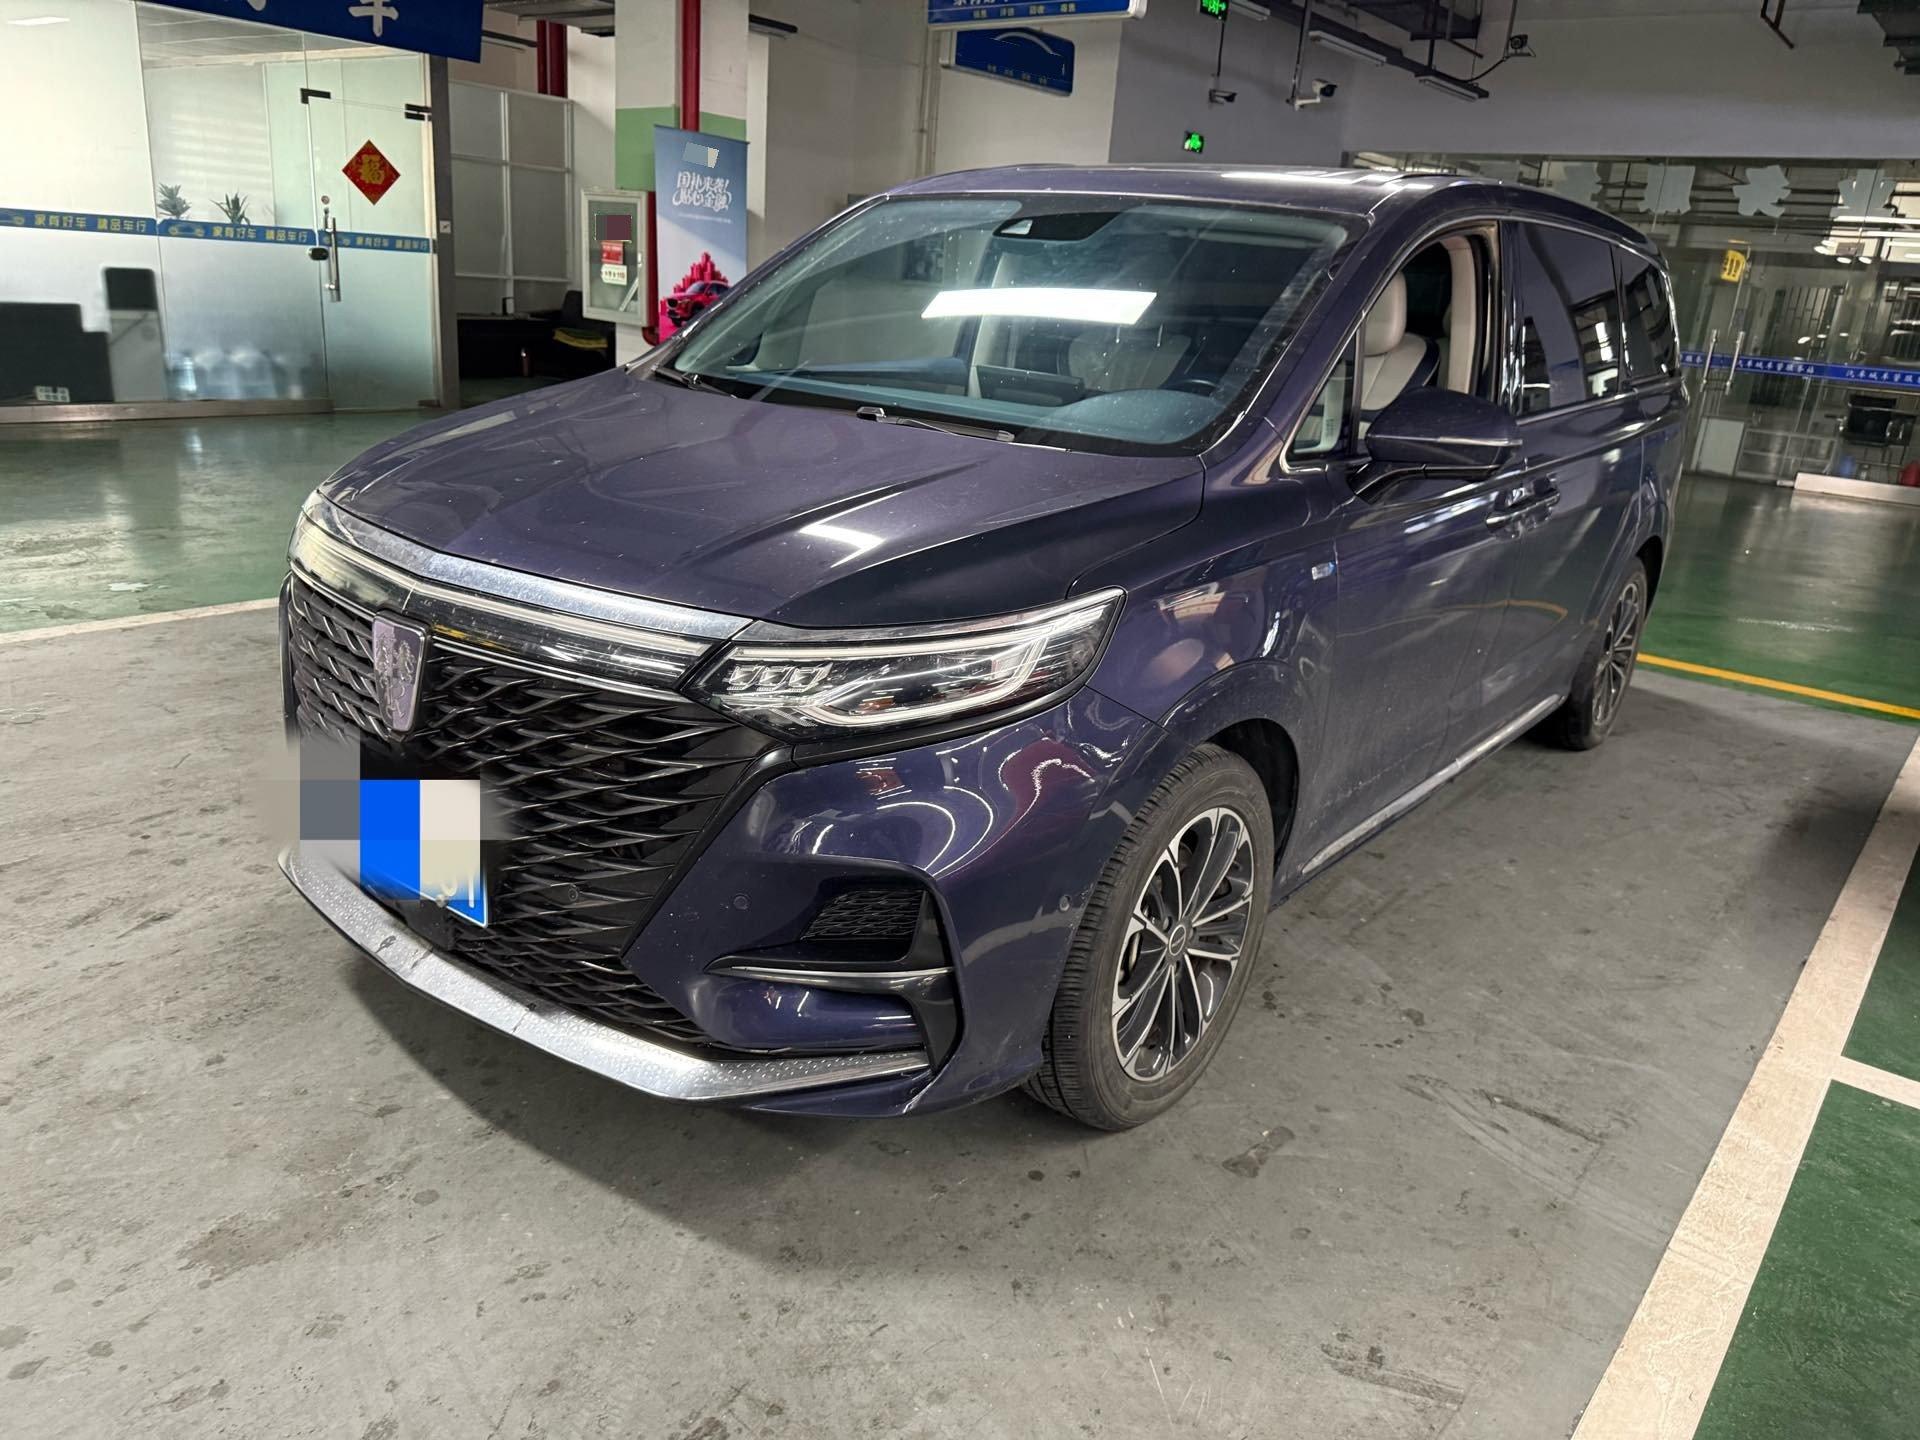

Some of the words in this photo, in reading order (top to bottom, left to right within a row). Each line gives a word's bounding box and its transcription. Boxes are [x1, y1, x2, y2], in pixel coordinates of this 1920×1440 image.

[360, 154, 385, 185] 福
[34, 213, 87, 229] 家有好车
